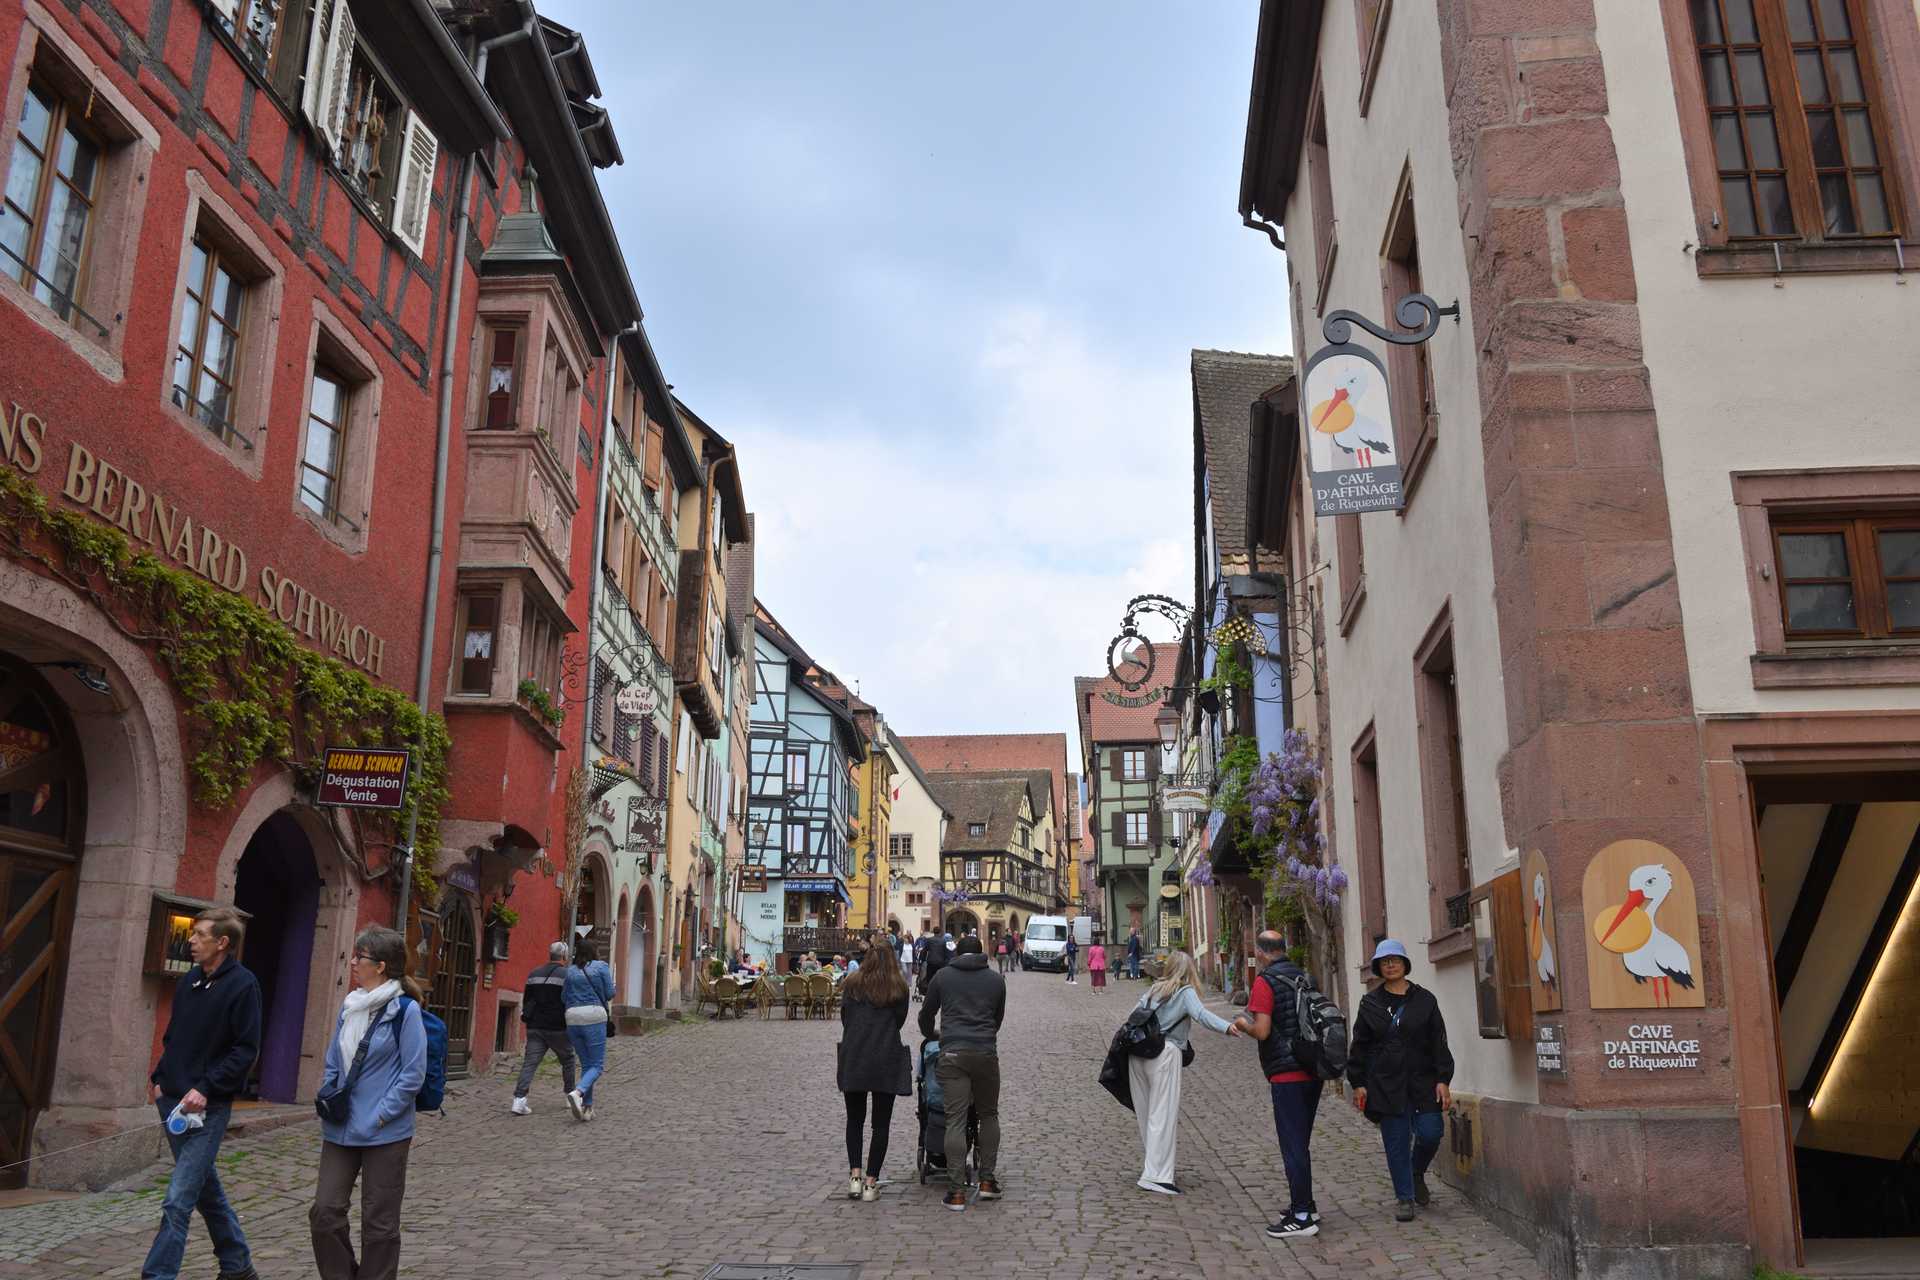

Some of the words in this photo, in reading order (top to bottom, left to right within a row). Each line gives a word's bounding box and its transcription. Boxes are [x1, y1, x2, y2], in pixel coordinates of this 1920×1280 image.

[1337, 472, 1375, 486] CAVE
[1317, 482, 1399, 500] D'AFFINAGE
[1321, 500, 1335, 511] de
[1339, 495, 1397, 510] Riquewihr
[63, 440, 248, 594] BERNARD
[257, 565, 386, 677] SCHWACH
[620, 688, 631, 698] Au
[619, 701, 629, 710] de
[631, 700, 653, 712] Vigne
[327, 753, 364, 771] BERNARD
[365, 754, 404, 773] SCHWACH
[326, 773, 400, 789] Dégustation
[344, 788, 378, 802] Vente
[1628, 1025, 1673, 1039] CAVE
[1604, 1039, 1700, 1055] D'AFFINAGE
[1608, 1055, 1625, 1070] de
[1629, 1054, 1698, 1071] Riquewihr
